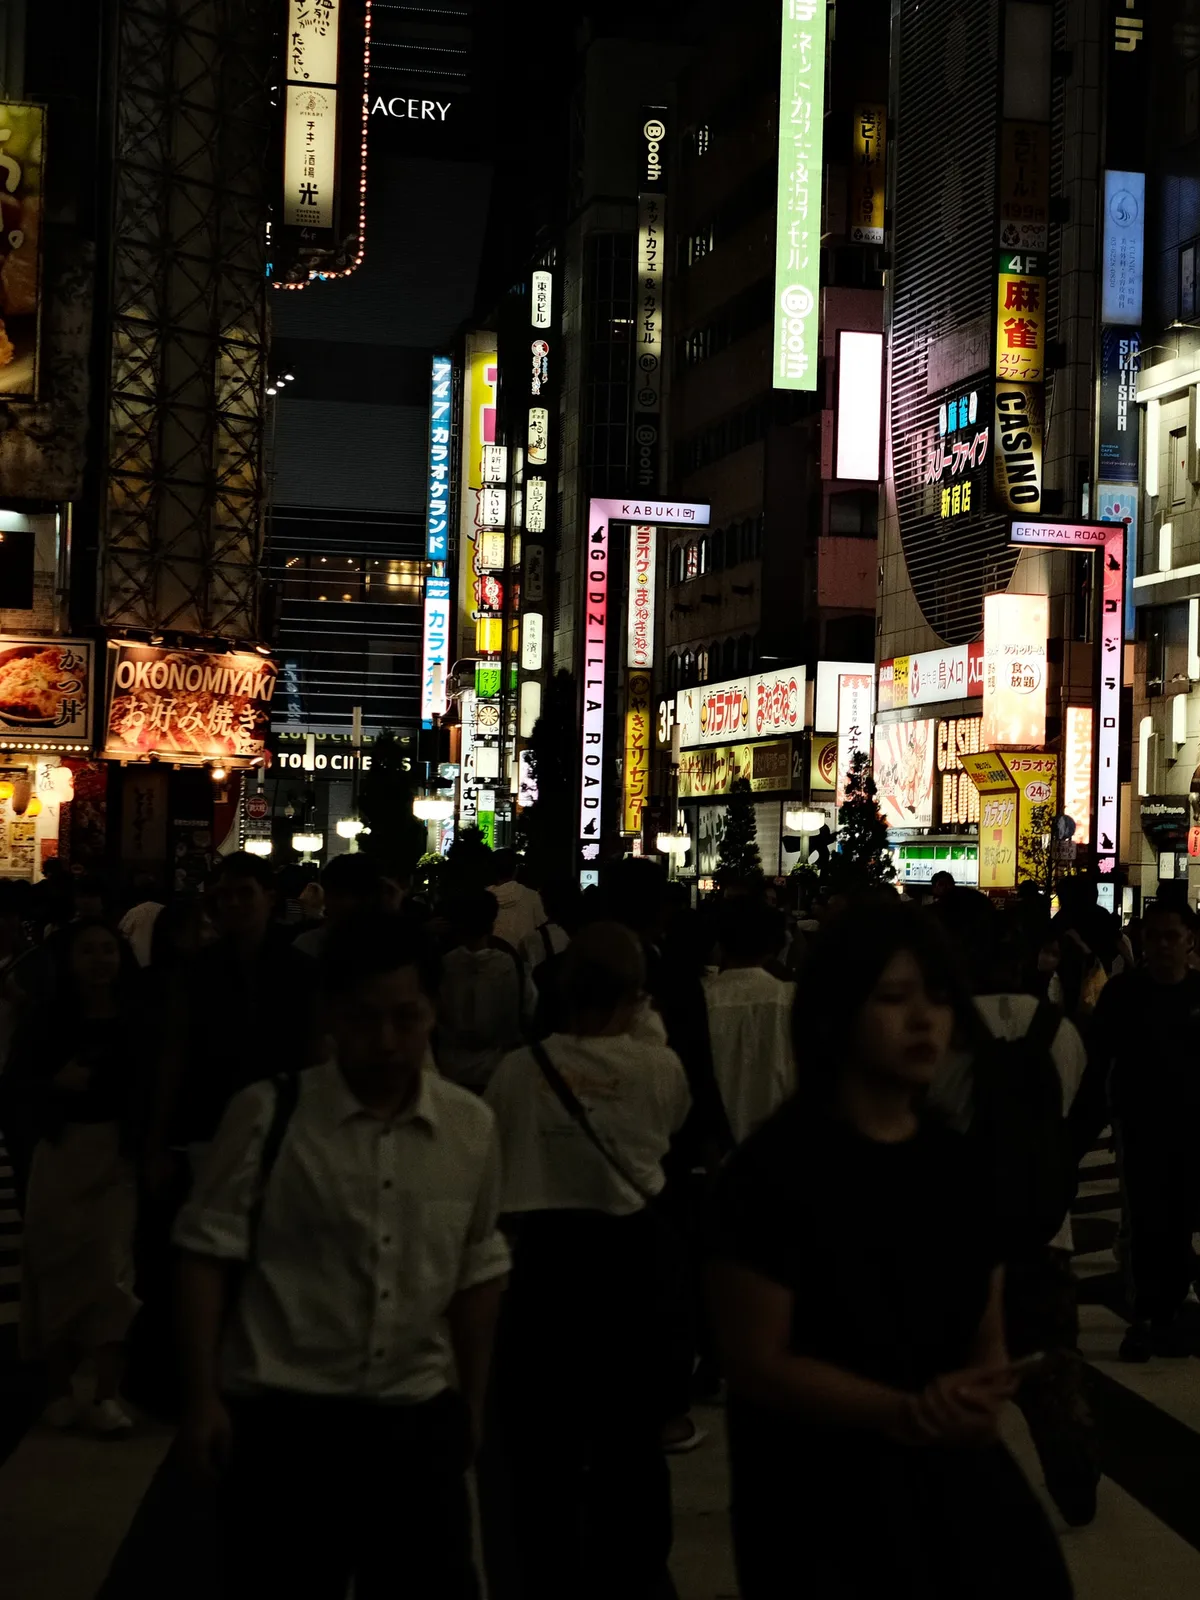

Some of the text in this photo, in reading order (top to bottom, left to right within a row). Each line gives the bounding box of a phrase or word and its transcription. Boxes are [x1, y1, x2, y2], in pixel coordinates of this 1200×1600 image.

[364, 97, 453, 122] ACERY
[643, 119, 666, 182] Booth
[298, 182, 320, 206] 光
[1002, 202, 1046, 221] 199円
[1008, 256, 1038, 273] 4F
[535, 281, 548, 323] 東京ビル
[643, 295, 656, 344] カプセル
[1003, 280, 1041, 350] 麻雀
[1000, 353, 1032, 364] スリー
[428, 363, 452, 554] 747 カラオケランド
[996, 391, 1040, 505] CASINO
[941, 481, 972, 518] 新宿店
[1016, 527, 1106, 541] CENTRAL ROAD
[634, 588, 650, 666] まねきねこ
[53, 649, 84, 727] かつ丼
[116, 660, 277, 701] OKONOMIYAKI
[583, 549, 606, 809] GODZILLA ROAD
[938, 658, 964, 690] 鳥メロ
[1010, 676, 1035, 689] 放題
[1011, 662, 1035, 674] 食べ
[121, 695, 257, 739] お好み焼き
[658, 699, 675, 743] 3F
[707, 688, 742, 732] カラオケ
[755, 678, 798, 735] まねきねこ
[1101, 598, 1121, 808] ゴジラロード
[277, 753, 328, 769] TOO
[627, 697, 649, 829] やきとりセンター
[1010, 759, 1056, 772] カラオケ
[982, 800, 1015, 828] カラオケ
